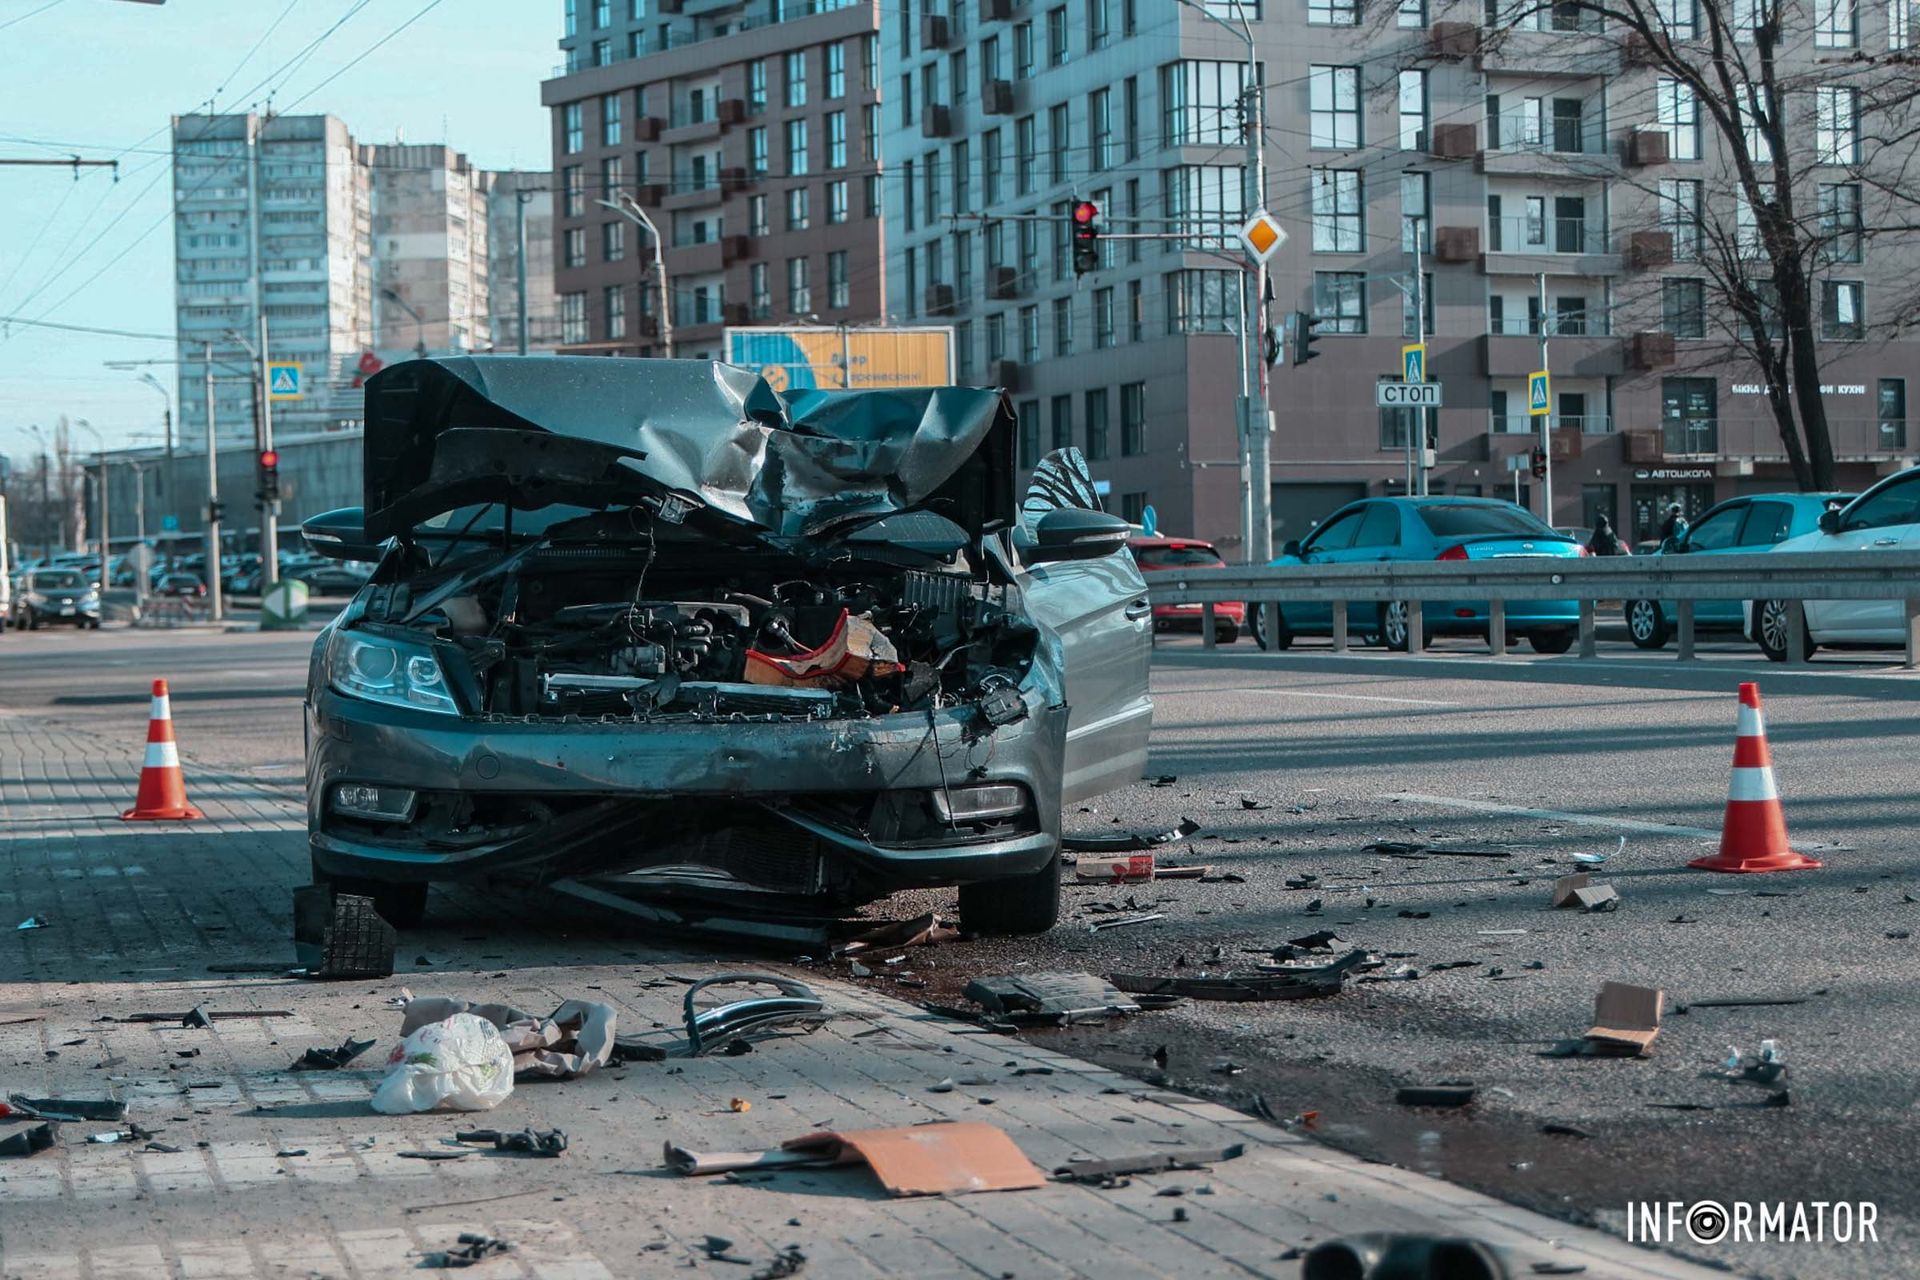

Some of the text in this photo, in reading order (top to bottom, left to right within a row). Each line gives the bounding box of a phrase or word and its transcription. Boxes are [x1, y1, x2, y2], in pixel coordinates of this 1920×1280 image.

[1384, 386, 1434, 402] СТОП
[1837, 385, 1866, 394] КУХНІ
[1651, 469, 1712, 478] АВТОШКОЛА
